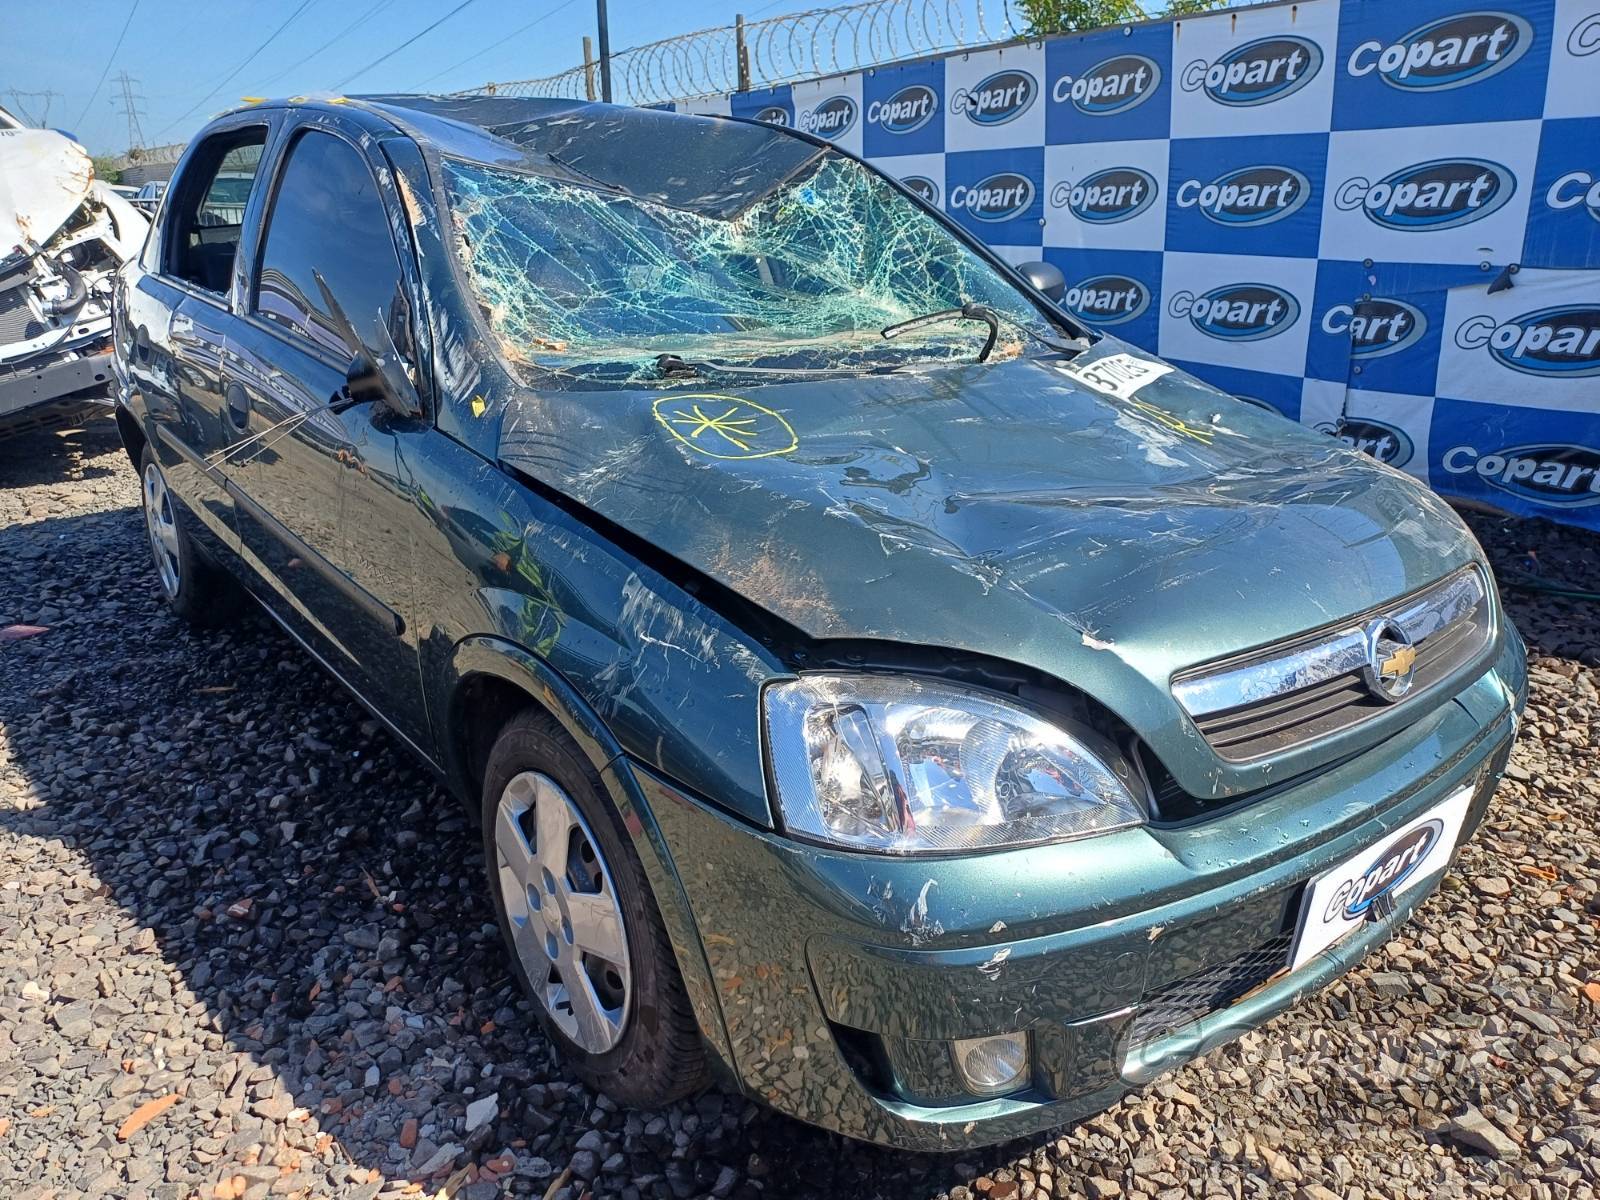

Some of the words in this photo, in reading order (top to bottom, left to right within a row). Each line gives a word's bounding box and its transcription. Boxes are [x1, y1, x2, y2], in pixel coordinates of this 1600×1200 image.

[1347, 22, 1509, 79] Copart
[1052, 66, 1147, 105] Copart
[1180, 49, 1303, 94] Copart
[867, 85, 930, 125] Copart
[950, 78, 1026, 116] Copart
[800, 104, 850, 133] Copart
[950, 184, 1025, 212] Copart
[1050, 179, 1143, 212] Copart
[1175, 175, 1294, 213] Copart
[1334, 172, 1490, 216] Copart
[1065, 286, 1138, 312] opart
[1168, 290, 1283, 326] Copart
[1454, 315, 1600, 358] Copar
[1323, 831, 1428, 923] Copart
